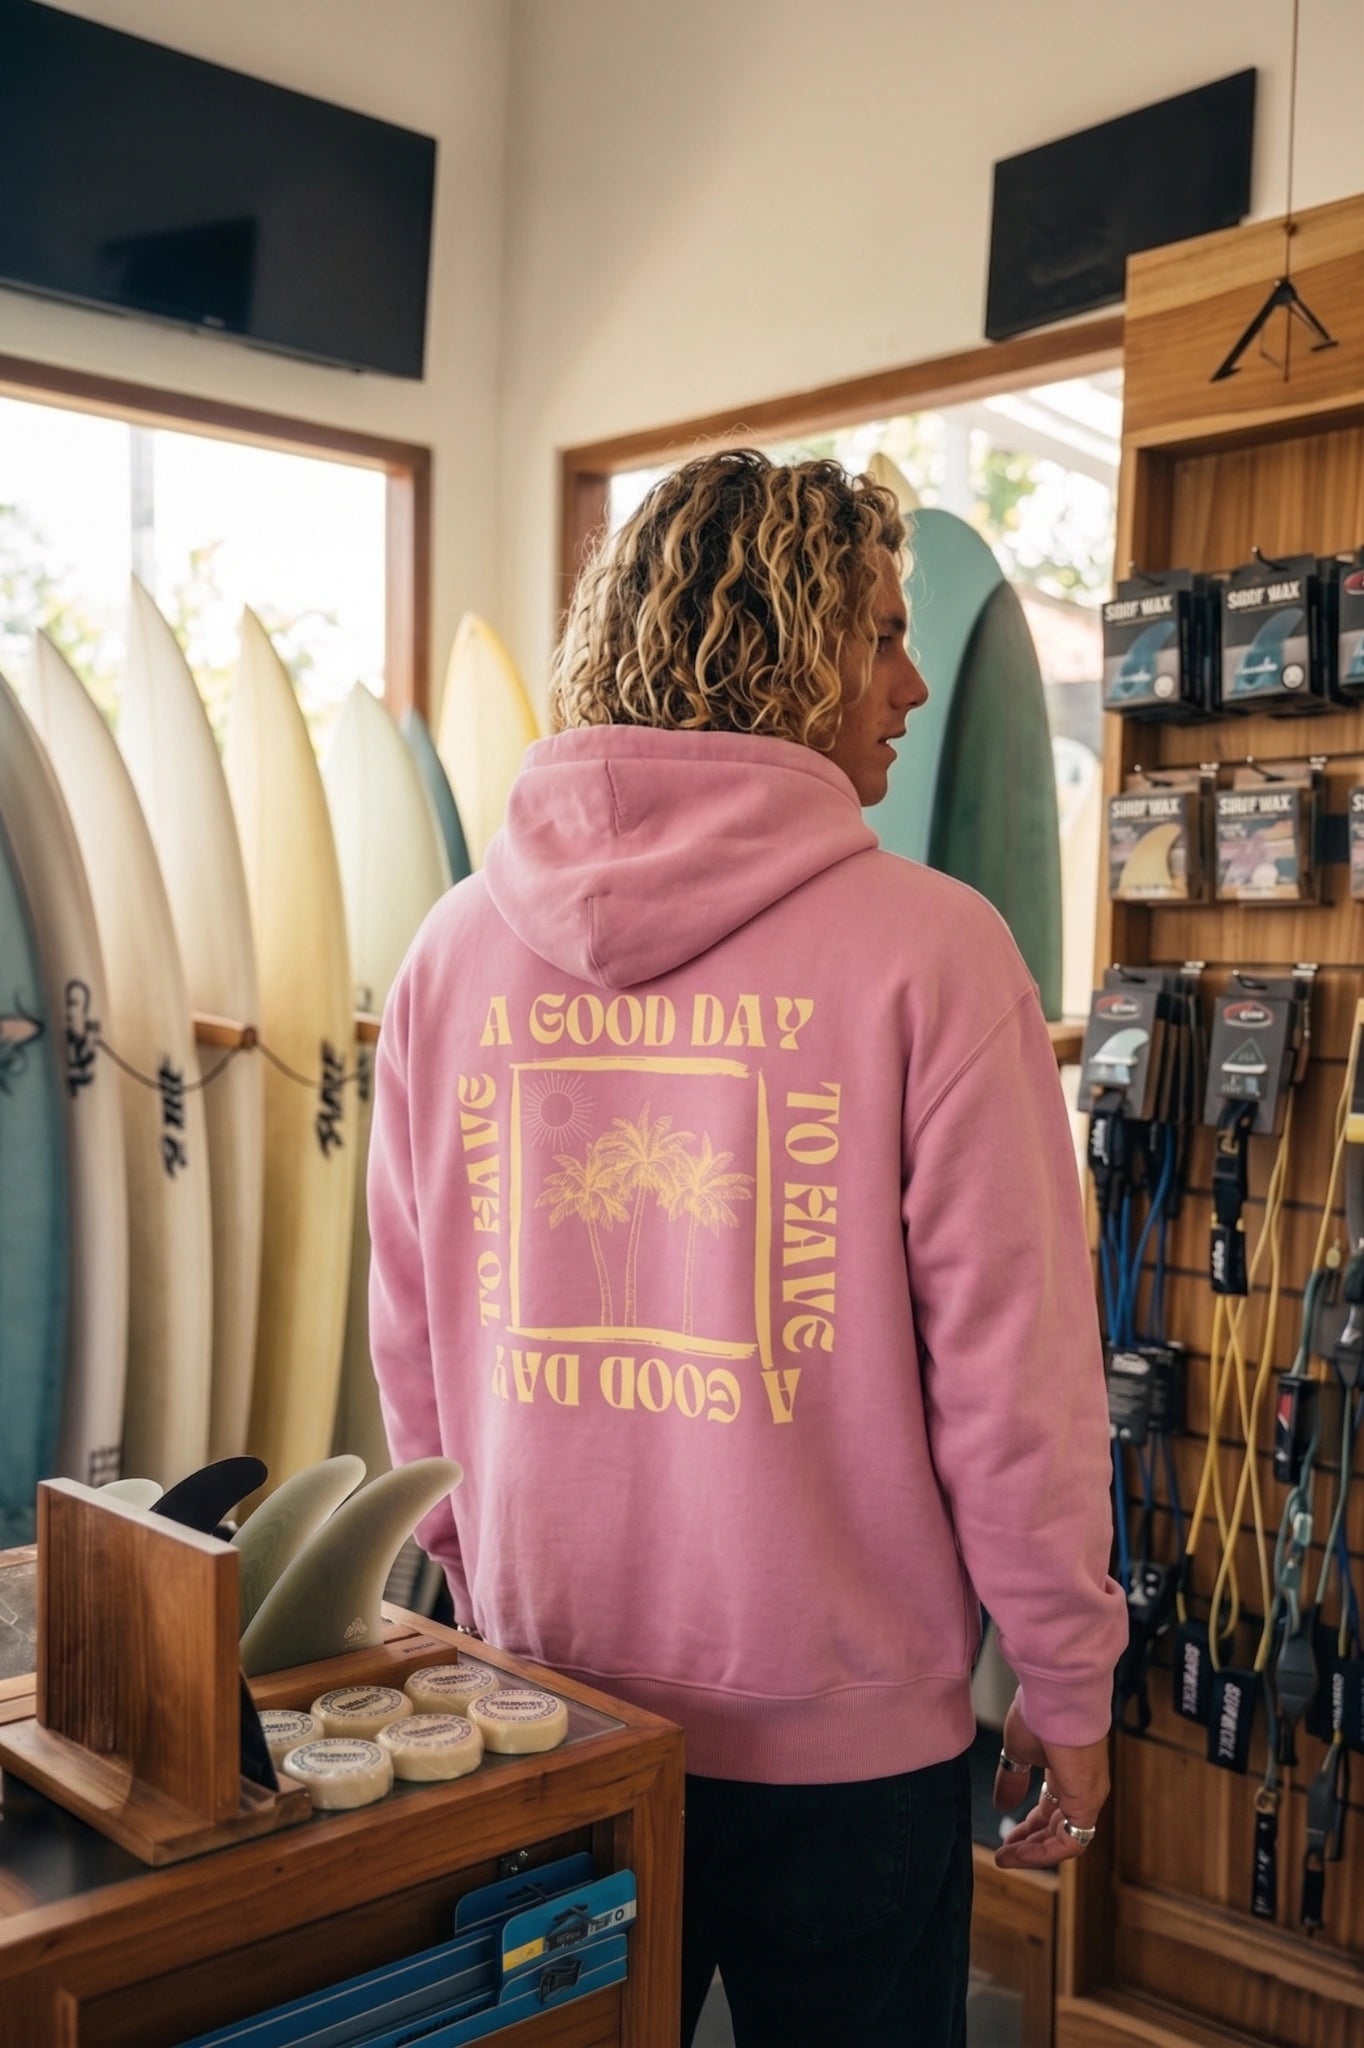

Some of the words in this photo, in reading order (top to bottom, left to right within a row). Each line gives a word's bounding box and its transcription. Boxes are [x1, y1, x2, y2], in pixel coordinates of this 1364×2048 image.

[1140, 595, 1173, 616] WAX
[1267, 581, 1300, 601] WAX
[1149, 798, 1181, 816] WAX
[1254, 794, 1292, 812] WAX
[480, 995, 514, 1047] A
[529, 993, 677, 1046] GOOD
[691, 993, 815, 1051] DAY
[458, 1072, 500, 1232] HAVE
[785, 1082, 842, 1166] TO
[477, 1250, 502, 1327] TO
[781, 1182, 838, 1353] HAVE
[491, 1344, 580, 1407] DAY
[600, 1356, 742, 1424] GOOD
[760, 1367, 802, 1425] A
